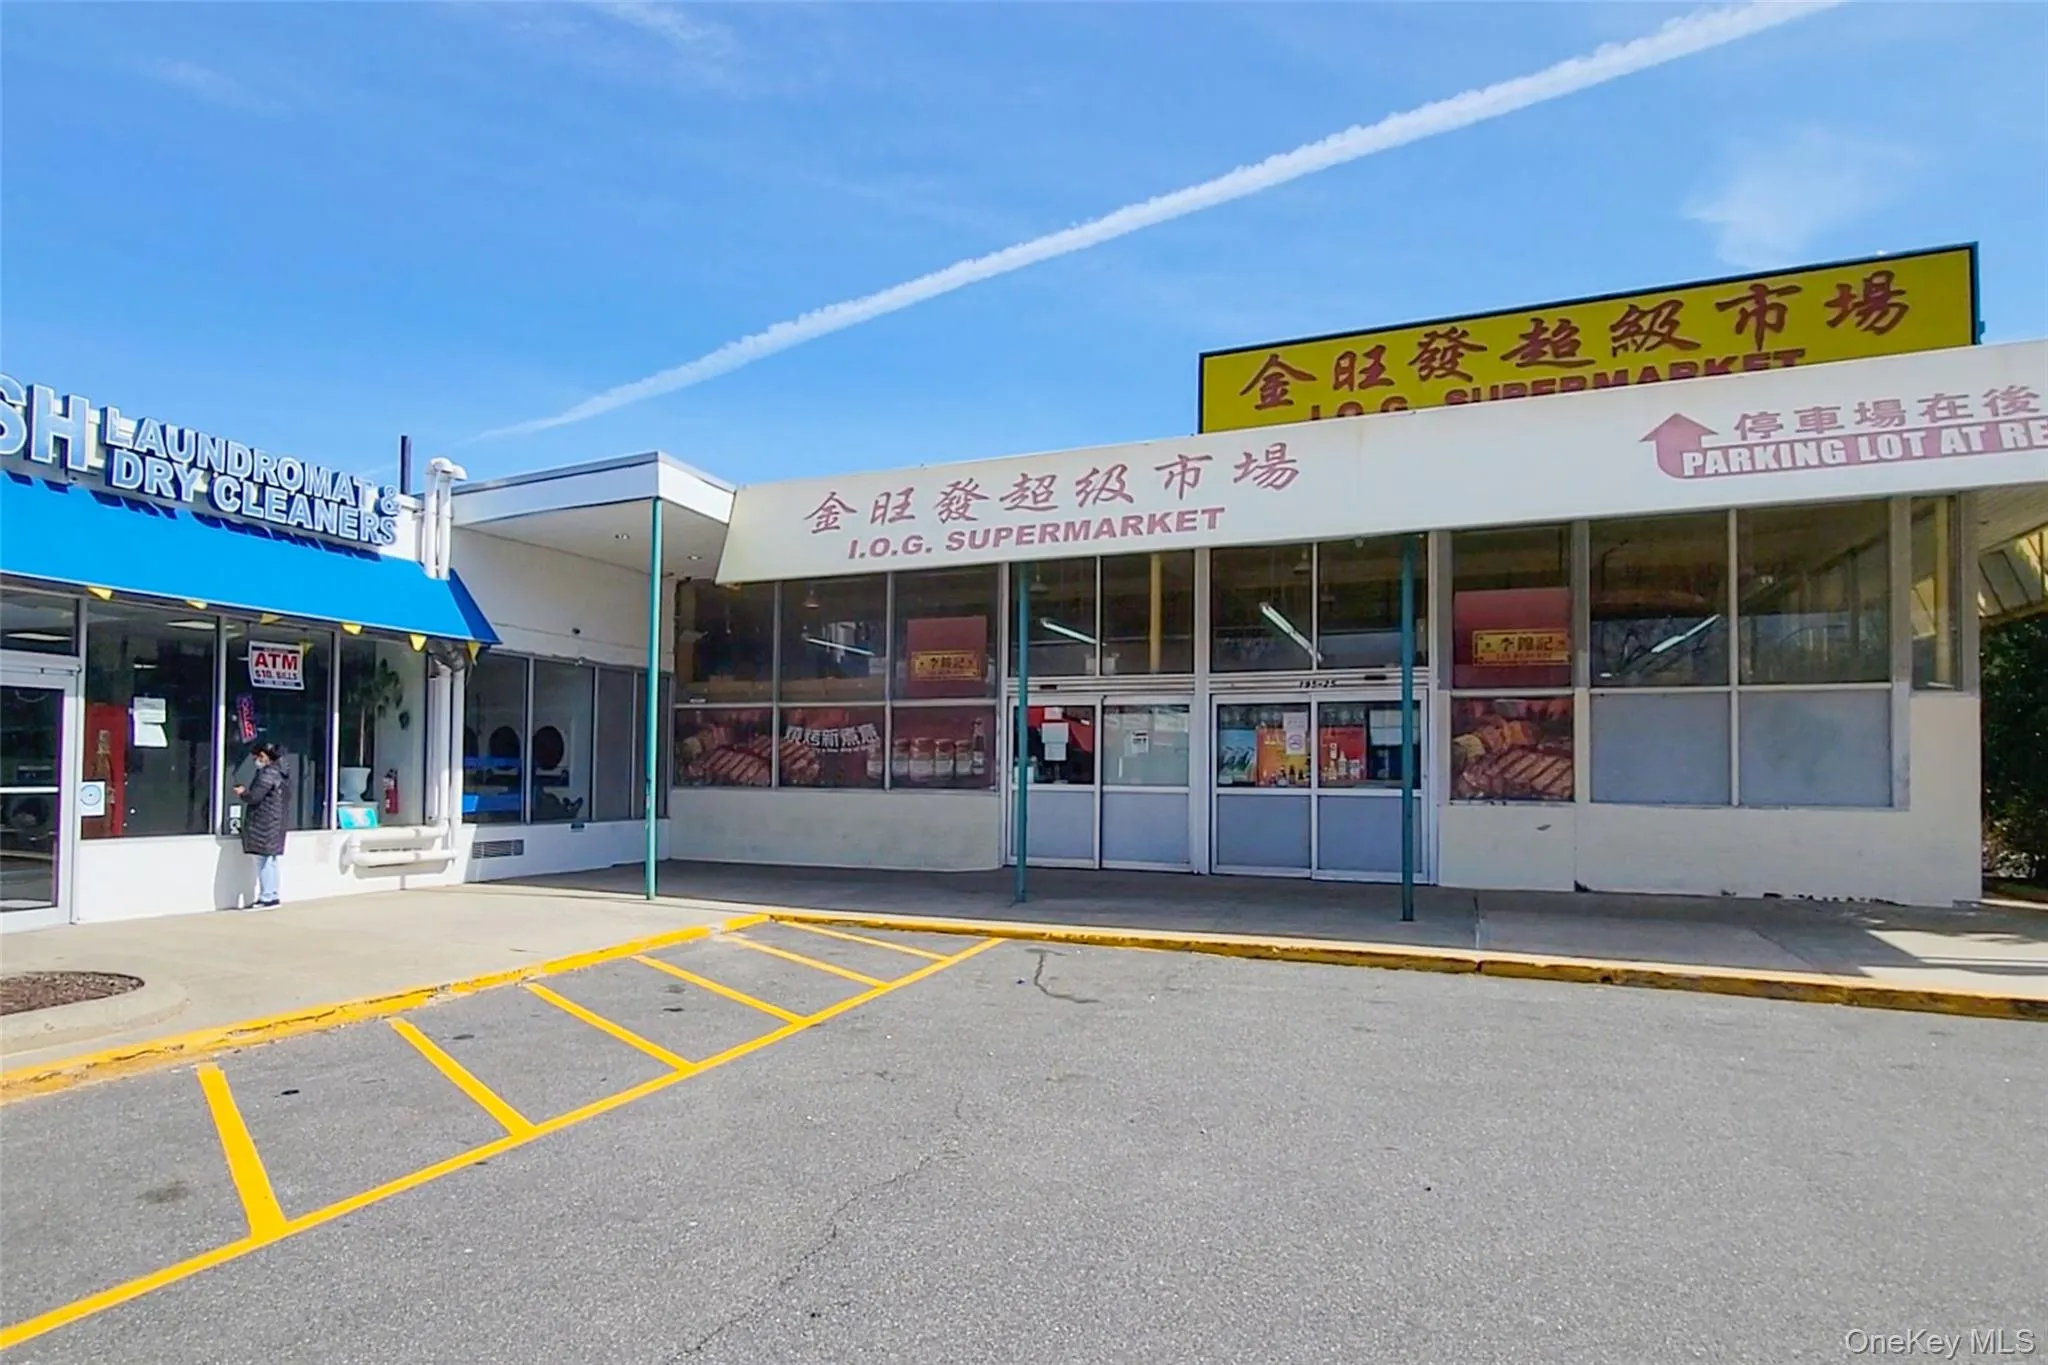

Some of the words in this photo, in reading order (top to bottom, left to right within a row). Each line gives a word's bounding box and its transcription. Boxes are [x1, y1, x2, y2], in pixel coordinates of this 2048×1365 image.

[1733, 384, 2040, 441] 停車場在後
[102, 405, 374, 508] LAUNDROMAT
[377, 484, 400, 515] &
[1682, 439, 1845, 477] PARKING
[1856, 431, 1926, 463] LOT
[1940, 425, 1986, 455] AT
[110, 448, 203, 502] DRY
[212, 474, 396, 545] CLEANERS
[848, 533, 933, 560] I.O.G.
[946, 506, 1226, 551] SUPERMARKET
[255, 652, 297, 671] ATM
